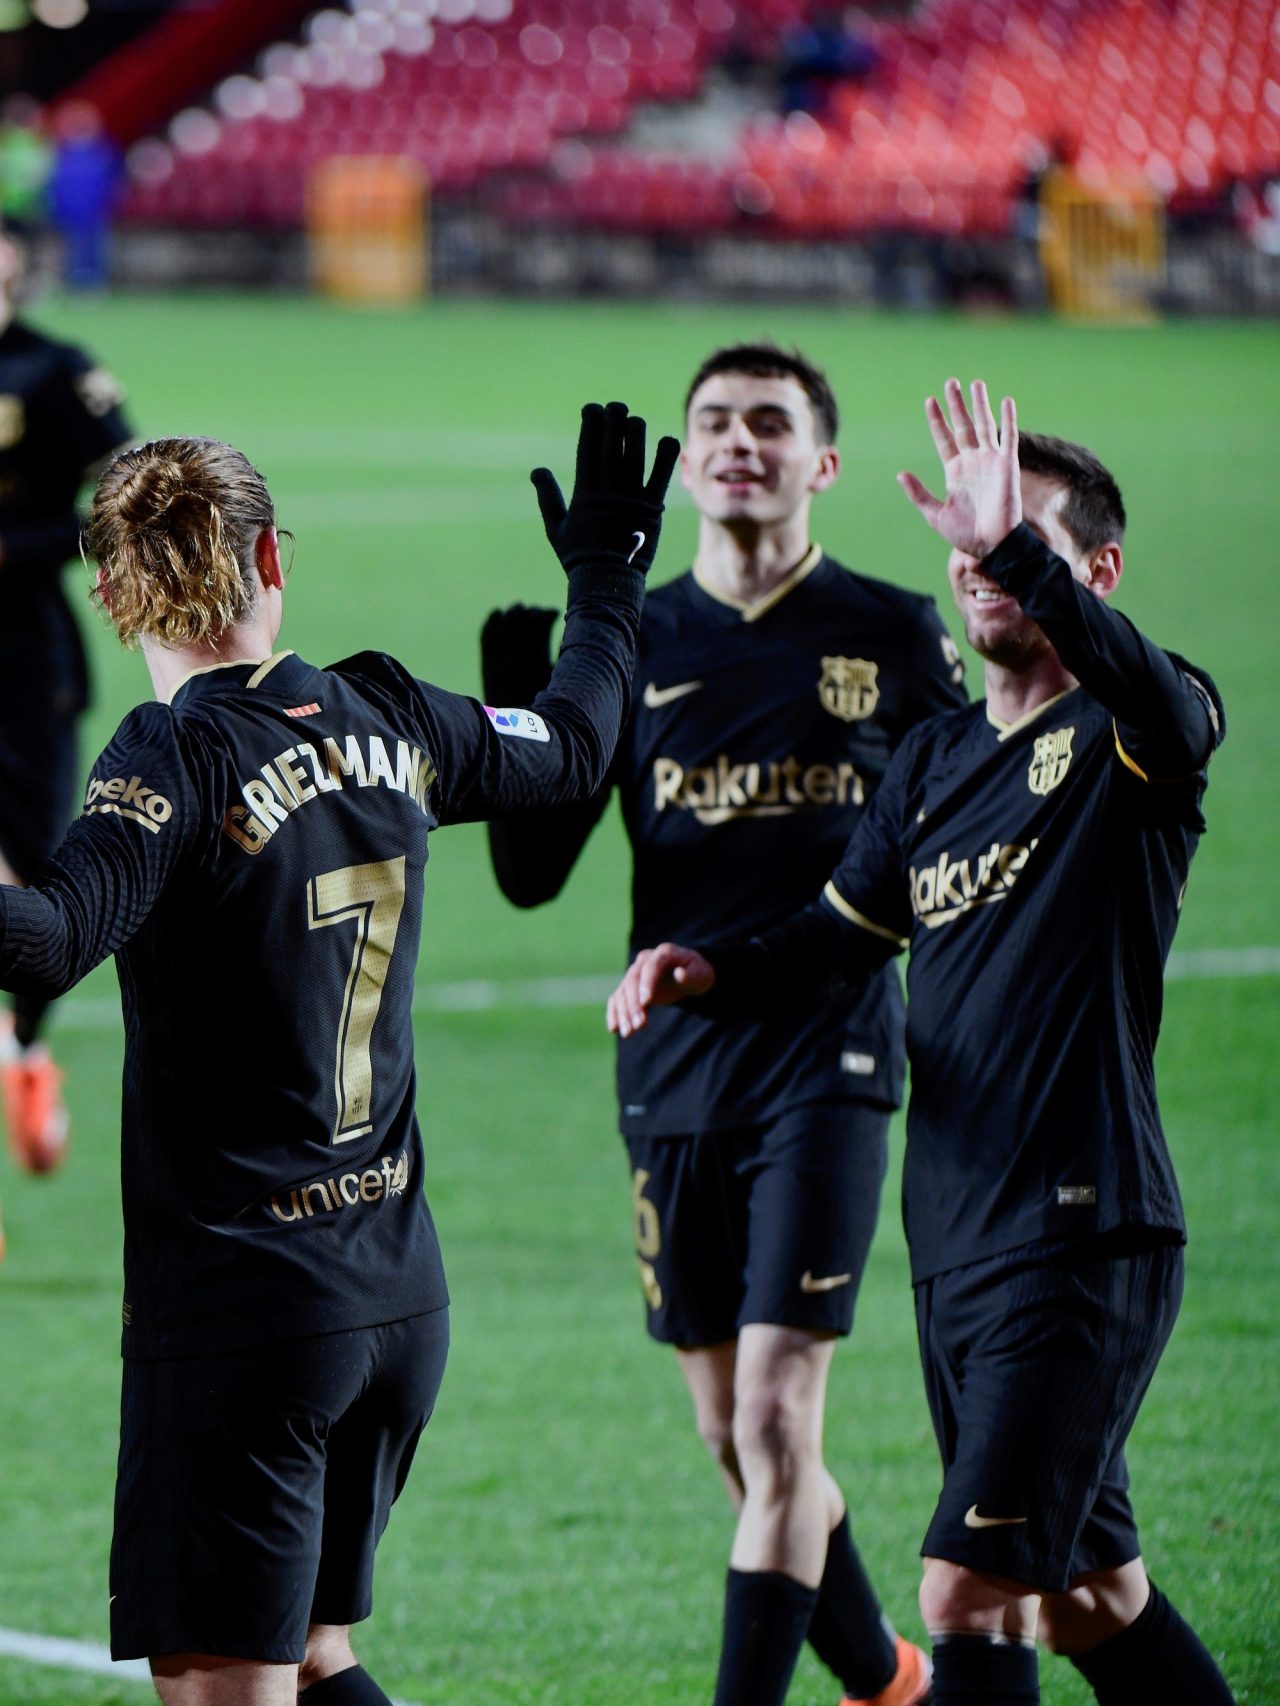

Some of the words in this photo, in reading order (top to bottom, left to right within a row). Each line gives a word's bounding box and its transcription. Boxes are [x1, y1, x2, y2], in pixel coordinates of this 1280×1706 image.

[85, 775, 173, 824] beko
[652, 753, 866, 814] Rakuten
[909, 838, 1039, 916] akute
[306, 855, 406, 1145] 7
[271, 1156, 395, 1223] unicef
